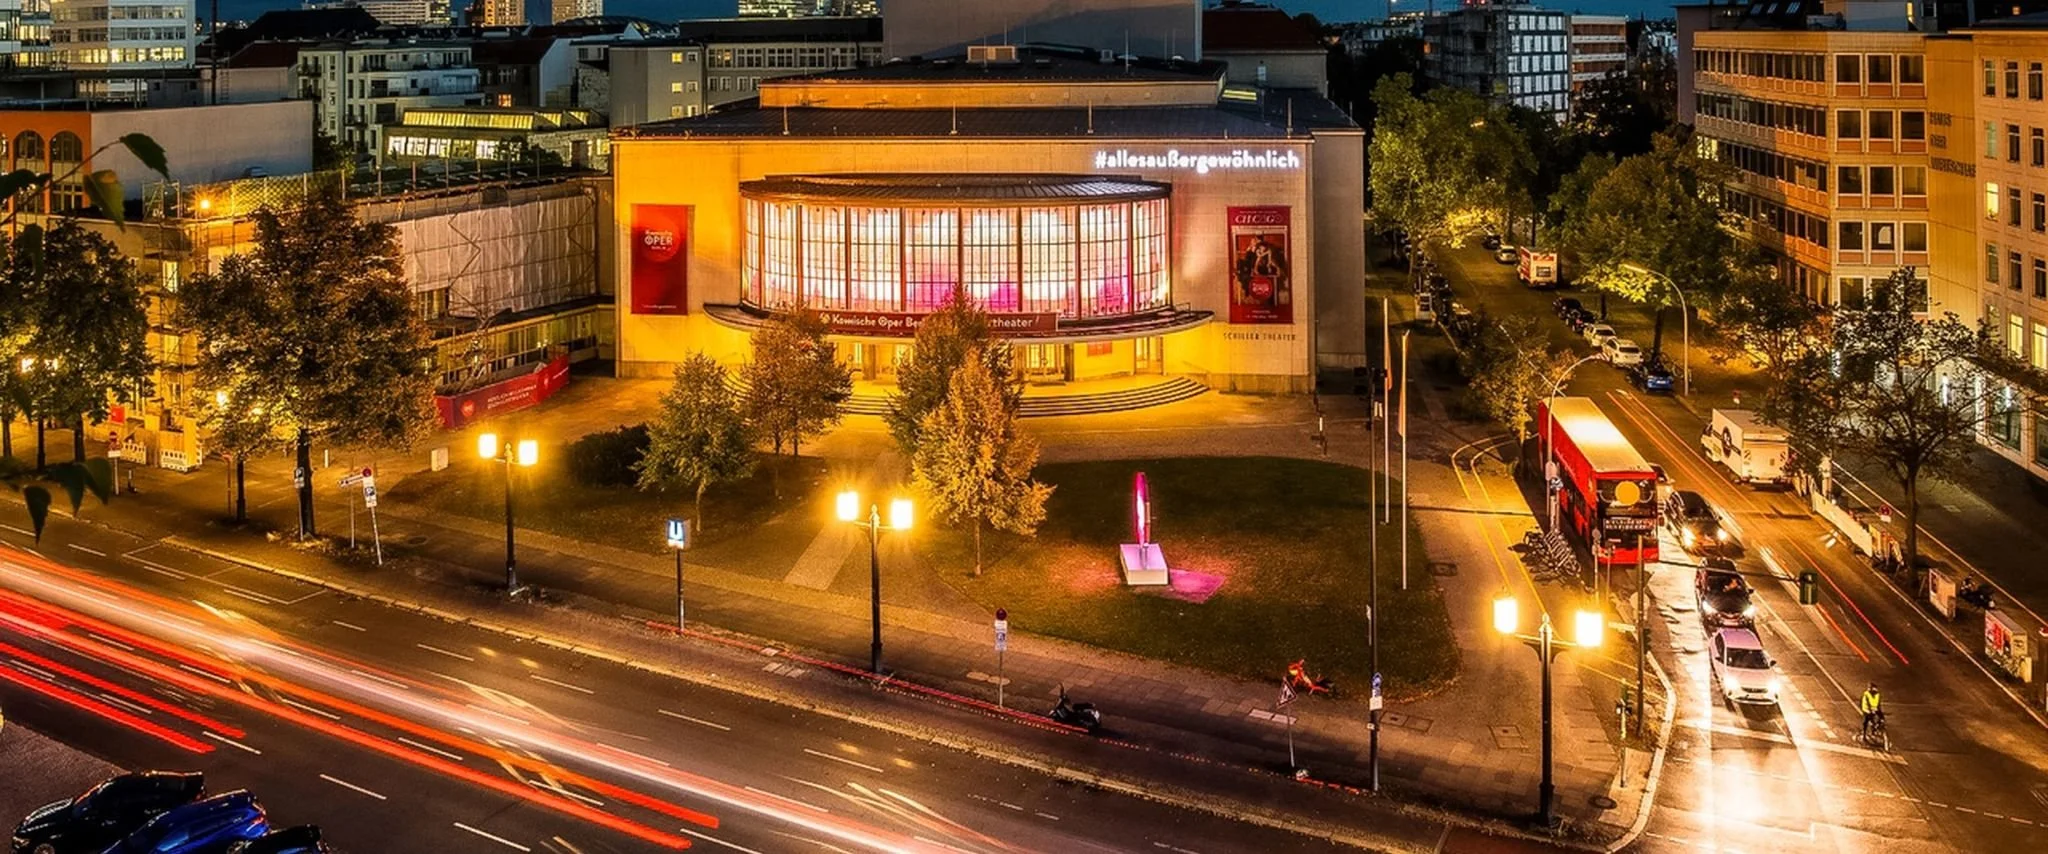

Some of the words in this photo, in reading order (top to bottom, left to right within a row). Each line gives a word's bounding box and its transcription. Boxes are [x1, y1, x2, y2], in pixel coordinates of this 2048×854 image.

[1095, 149, 1299, 174] #allesaußergewöhnlich
[832, 313, 876, 327] Komische
[878, 316, 903, 330] Oper
[1223, 331, 1259, 341] SCHILLER
[1263, 333, 1297, 342] THEATER
[669, 520, 683, 540] U
